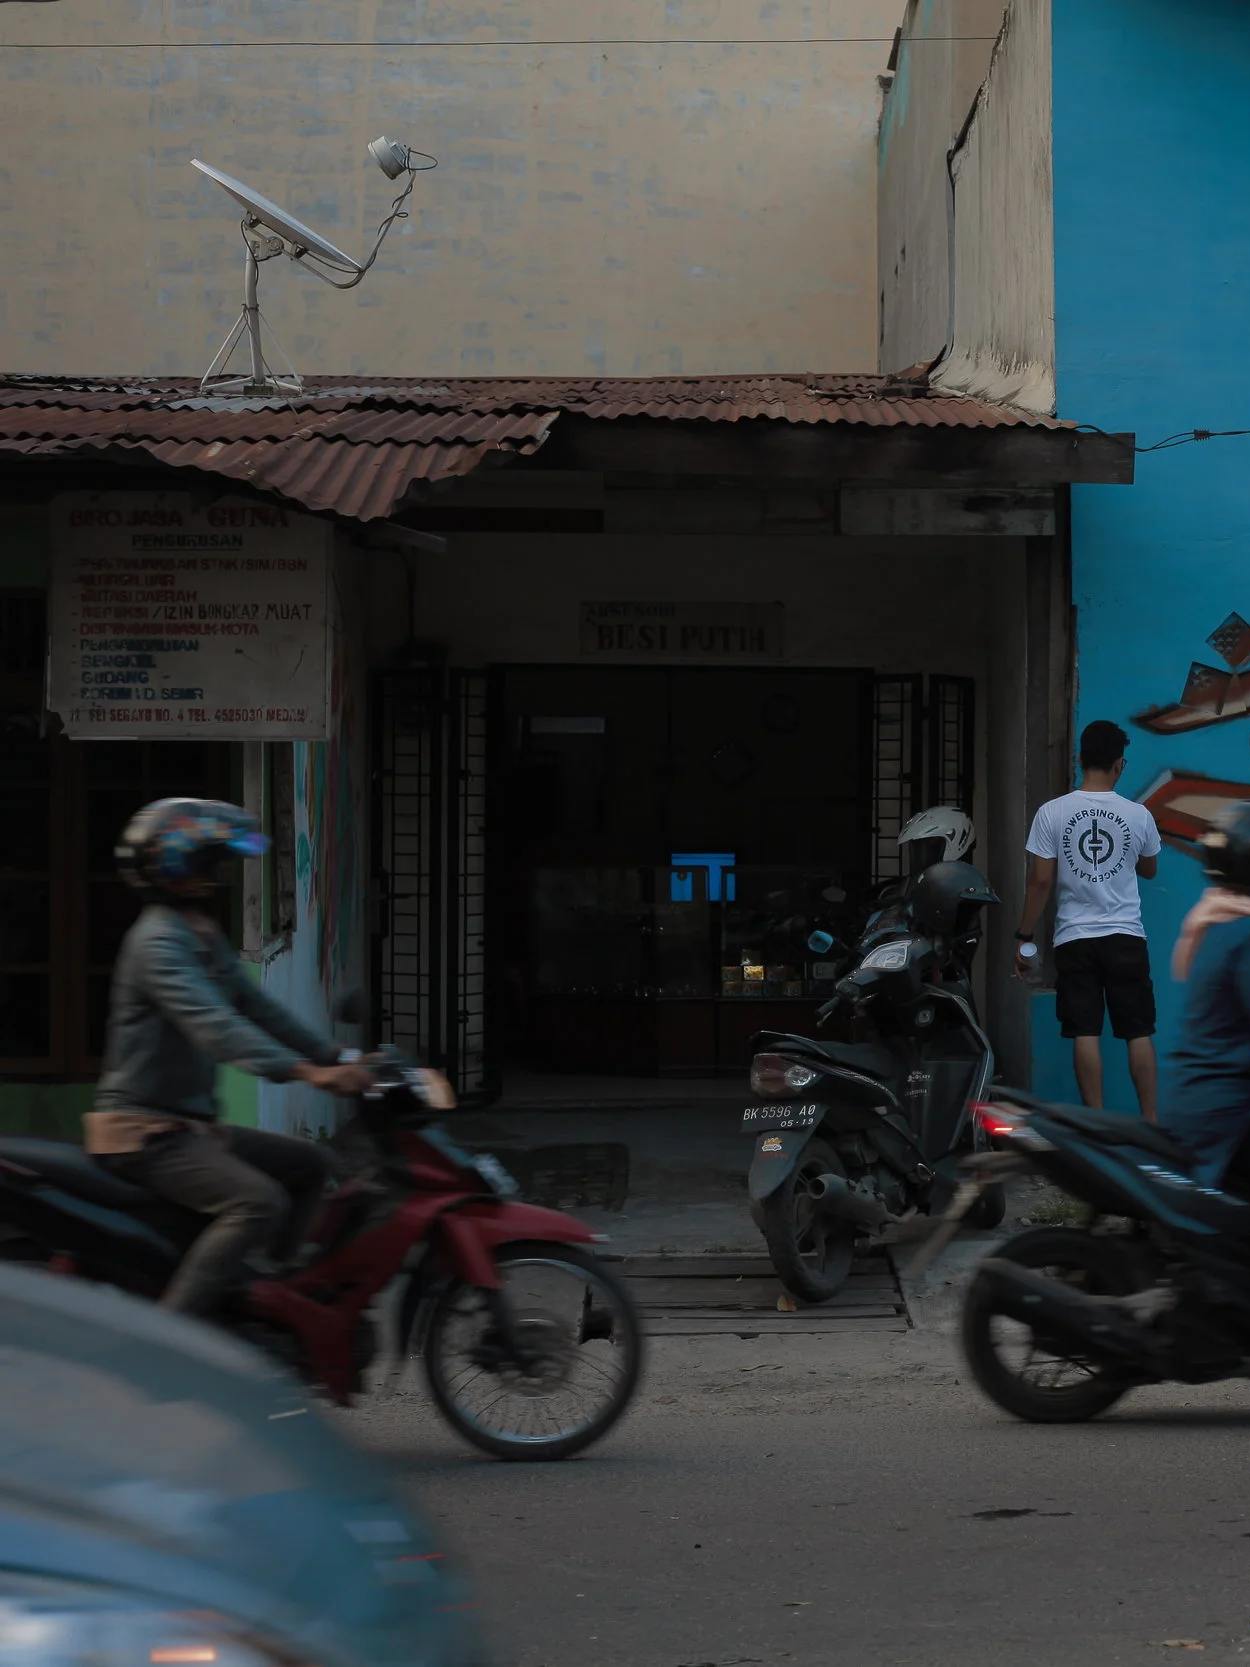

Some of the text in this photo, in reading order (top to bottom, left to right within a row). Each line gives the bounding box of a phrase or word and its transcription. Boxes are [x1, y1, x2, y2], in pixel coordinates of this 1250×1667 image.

[69, 509, 122, 527] BIRO
[126, 508, 184, 527] JASA
[136, 590, 198, 603] DAERAH
[596, 623, 766, 653] BESI PUTIH
[81, 670, 150, 684] GUDANG
[187, 708, 211, 722] TEL.
[742, 1107, 760, 1121] BK
[761, 1106, 793, 1119] 5596
